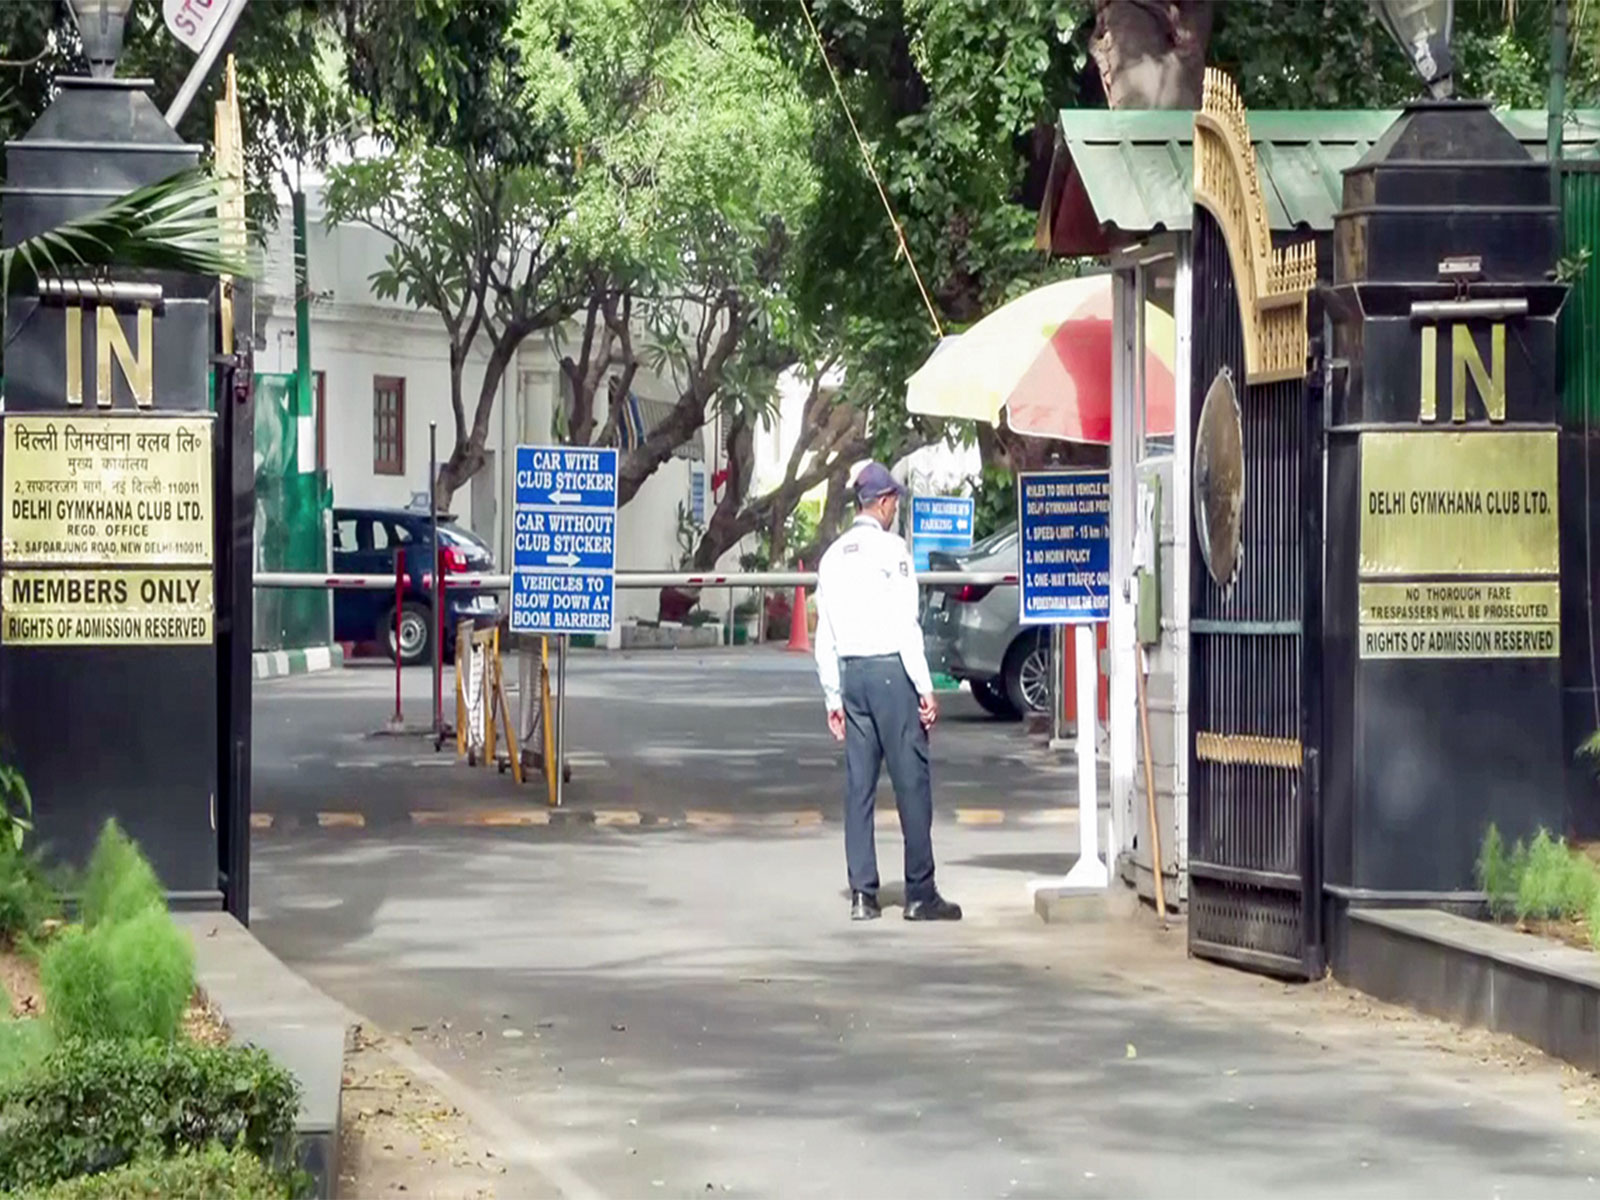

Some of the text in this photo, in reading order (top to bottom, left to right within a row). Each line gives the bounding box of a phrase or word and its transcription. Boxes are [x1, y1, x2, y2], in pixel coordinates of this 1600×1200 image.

[66, 306, 153, 406] IN
[1421, 324, 1505, 421] IN
[15, 425, 58, 451] दिल्ली
[65, 425, 130, 452] जिमखाना
[67, 455, 149, 476] मुख्य कार्यालय
[533, 452, 599, 471] CAR WITH
[517, 470, 614, 491] CLUB STICKER
[12, 499, 204, 520] DELHI GYMKHANA CLUB LTD.
[1369, 491, 1551, 514] DELHI GYMKHANA CLUB LTD.
[67, 524, 149, 537] REGD. OFFICE
[516, 514, 613, 534] CAR WITHOUT
[1033, 526, 1054, 541] SPEED
[1056, 526, 1074, 540] LIMIT
[25, 541, 88, 554] SAFDARJUNG
[120, 541, 141, 554] NEW
[515, 534, 612, 554] CLUB STICKER
[1045, 550, 1065, 564] HORN
[1066, 549, 1091, 563] POLICY
[521, 576, 604, 593] VEHICLES TO
[1034, 573, 1066, 587] ONE-WAY
[1067, 572, 1096, 586] TRAFFIC
[12, 578, 201, 604] MEMBERS ONLY
[1406, 587, 1511, 601] NO THOROUGH FARE
[514, 593, 610, 611] SLOW DOWN AT
[1371, 605, 1548, 619] TRESPASSERS WILL BE PROSECUTED
[9, 616, 206, 638] RIGHTS OF ADMISSION RESERVED
[513, 610, 610, 628] BOOM BARRIER
[1366, 630, 1553, 653] RIGHTS OF ADMISSION RESERVED
